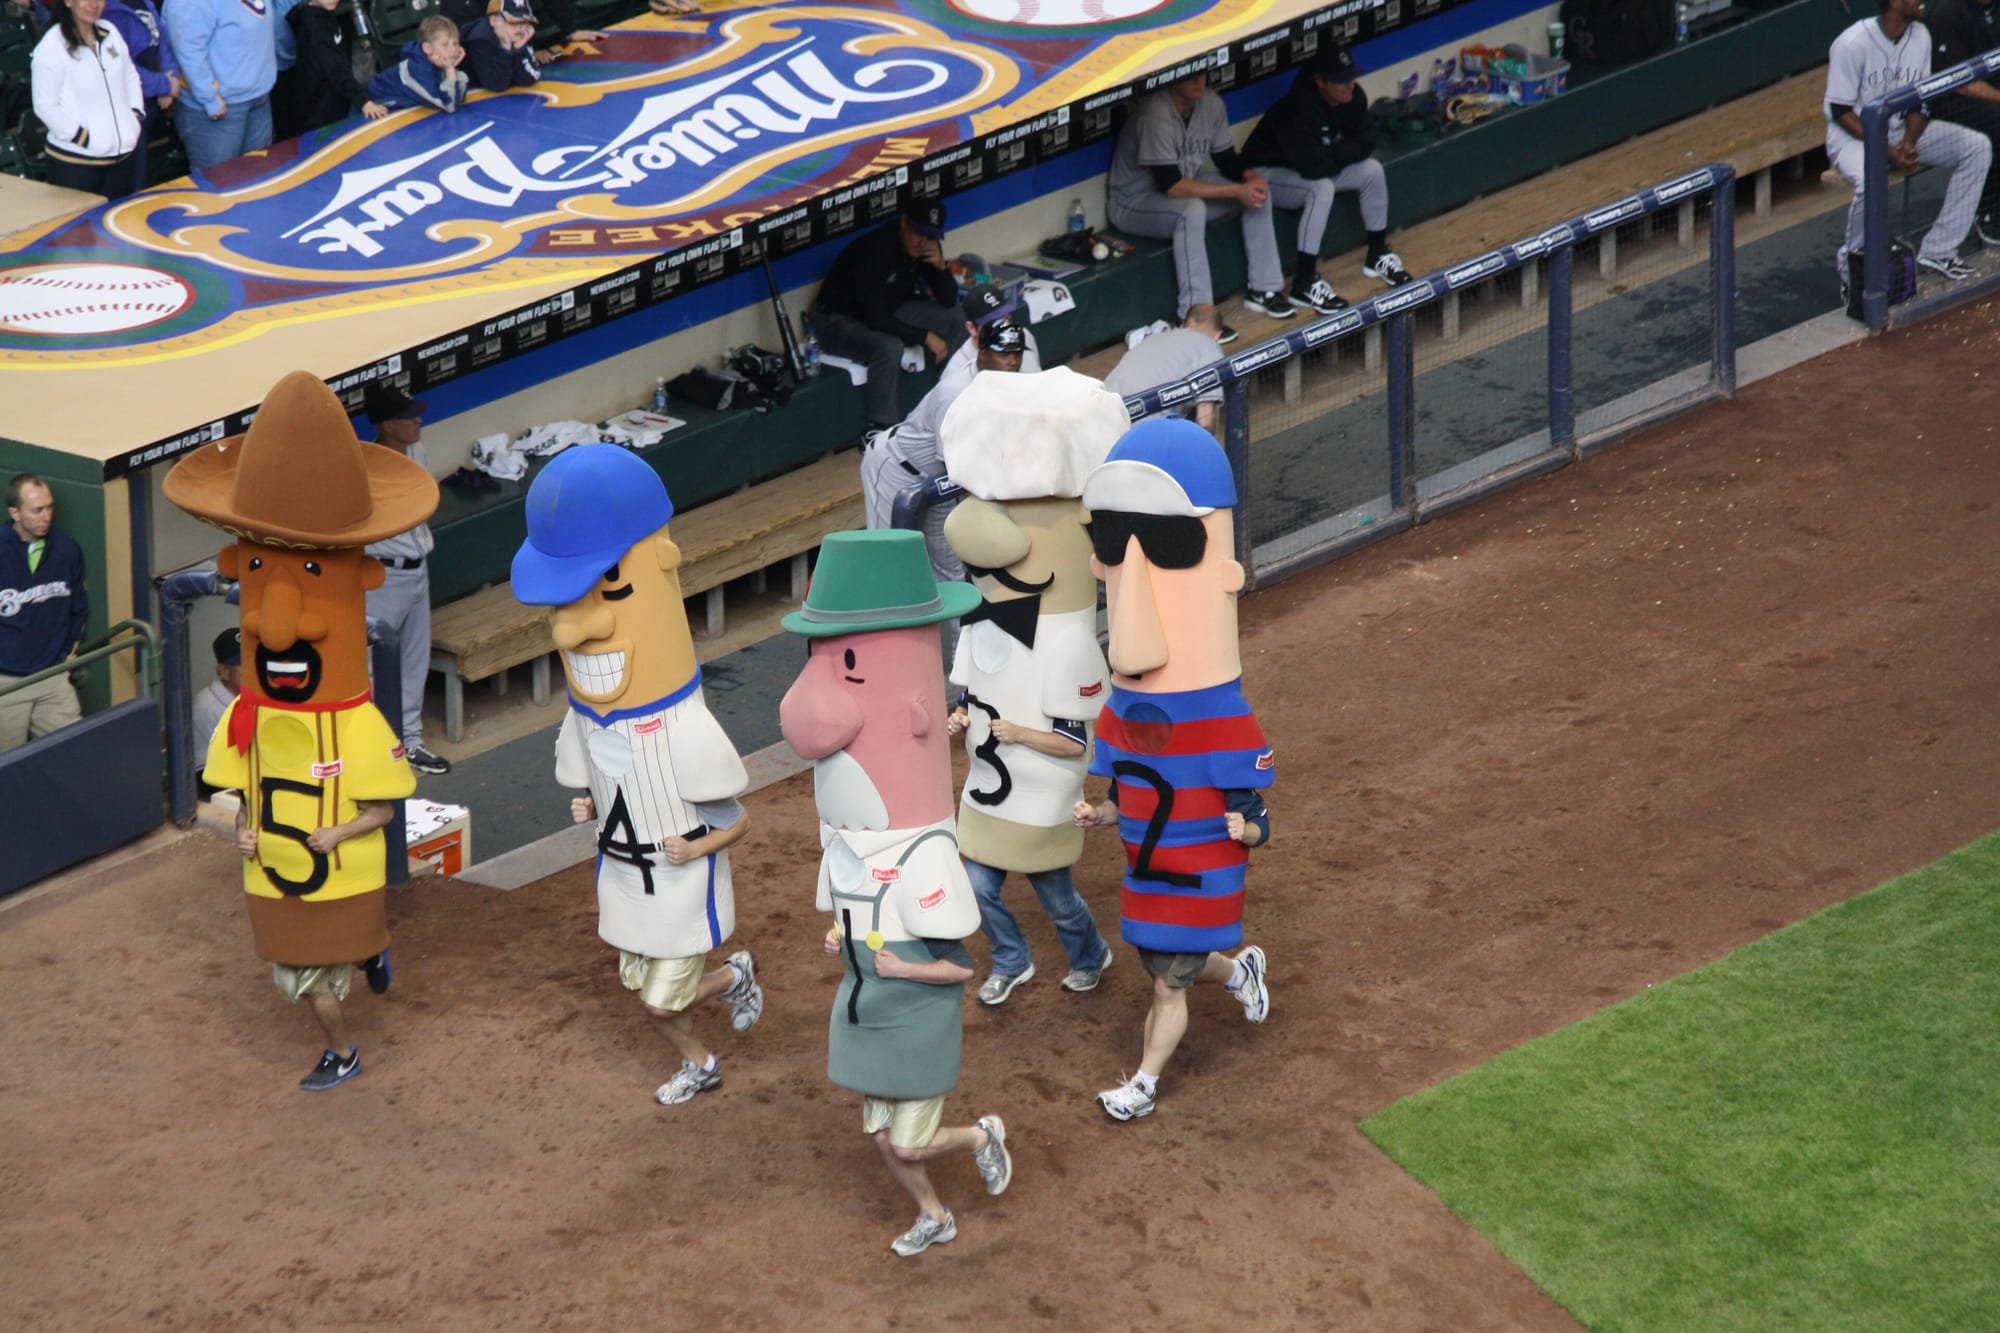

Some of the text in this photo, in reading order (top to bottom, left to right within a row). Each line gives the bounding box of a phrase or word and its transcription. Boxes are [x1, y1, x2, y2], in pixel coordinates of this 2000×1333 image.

[1303, 18, 1315, 31] FLY
[1315, 10, 1332, 26] YOUR
[1332, 4, 1348, 19] OWN
[1146, 58, 1208, 90] FLY YOUR OWN FLAG
[985, 117, 1048, 150] FLY YOUR OWN FLAG
[299, 50, 949, 258] Miller Park
[822, 177, 885, 211] FLY YOUR OWN FLAG
[1659, 172, 1711, 199] brewers.com
[1589, 201, 1641, 226] brewers.com
[655, 239, 721, 273] FLY YOUR OWN FLAG
[1377, 286, 1430, 312] brewers.com
[484, 302, 551, 336] FLY YOUR OWN FLAG
[1307, 315, 1359, 342] brewers.com
[1235, 344, 1287, 372] brewers.com
[342, 373, 360, 390] OWN
[360, 366, 378, 382] FLAG
[130, 432, 200, 467] FLY YOUR OWN FLAG
[967, 693, 1012, 806] 3
[261, 777, 329, 896] 5
[598, 784, 656, 895] 4
[1112, 760, 1202, 889] 2
[842, 908, 863, 1024] 1
